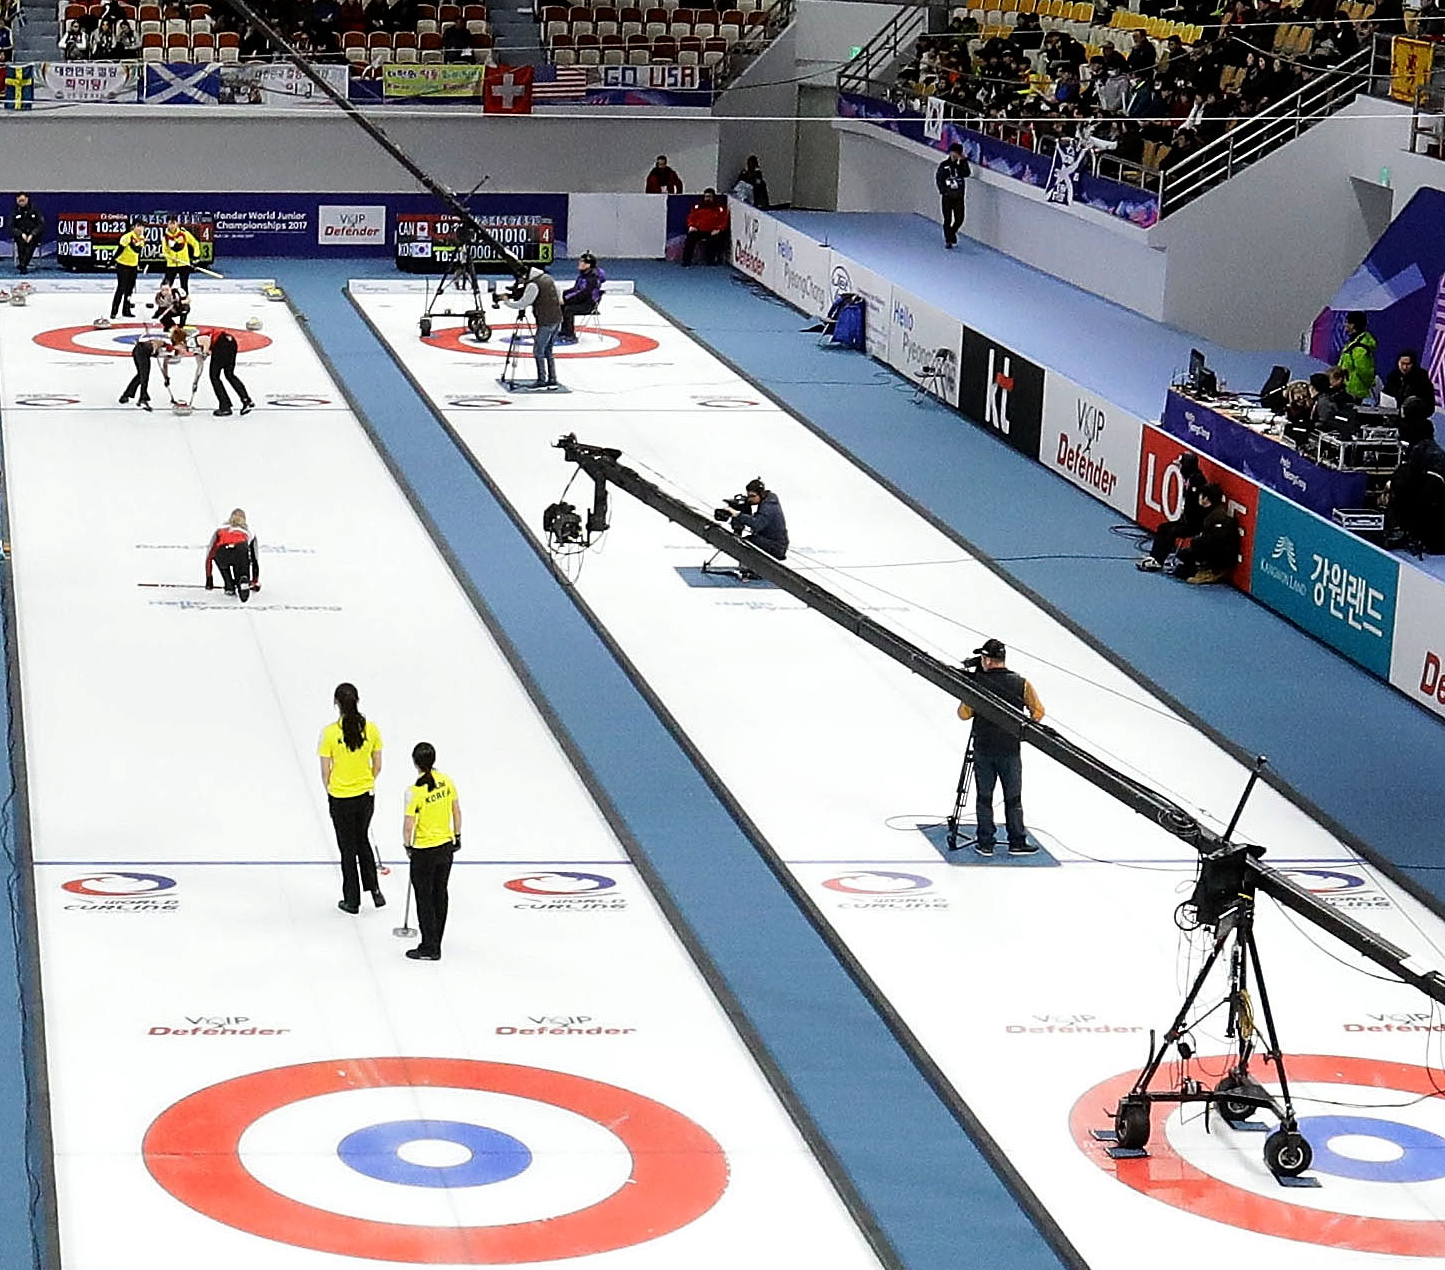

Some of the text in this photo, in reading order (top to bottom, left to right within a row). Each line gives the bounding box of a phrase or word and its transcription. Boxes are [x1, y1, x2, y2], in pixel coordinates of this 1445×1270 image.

[248, 210, 306, 220] World Junior
[58, 221, 126, 235] CAN 10:23
[216, 220, 308, 231] Championships 2017
[324, 225, 380, 239] Defender
[398, 221, 415, 236] CAN
[893, 300, 914, 330] Hello
[984, 347, 1015, 435] kt
[1057, 433, 1118, 496] Defender
[1310, 553, 1386, 639] 강원랜드
[148, 1025, 291, 1037] Defender
[494, 1025, 639, 1036] Defender
